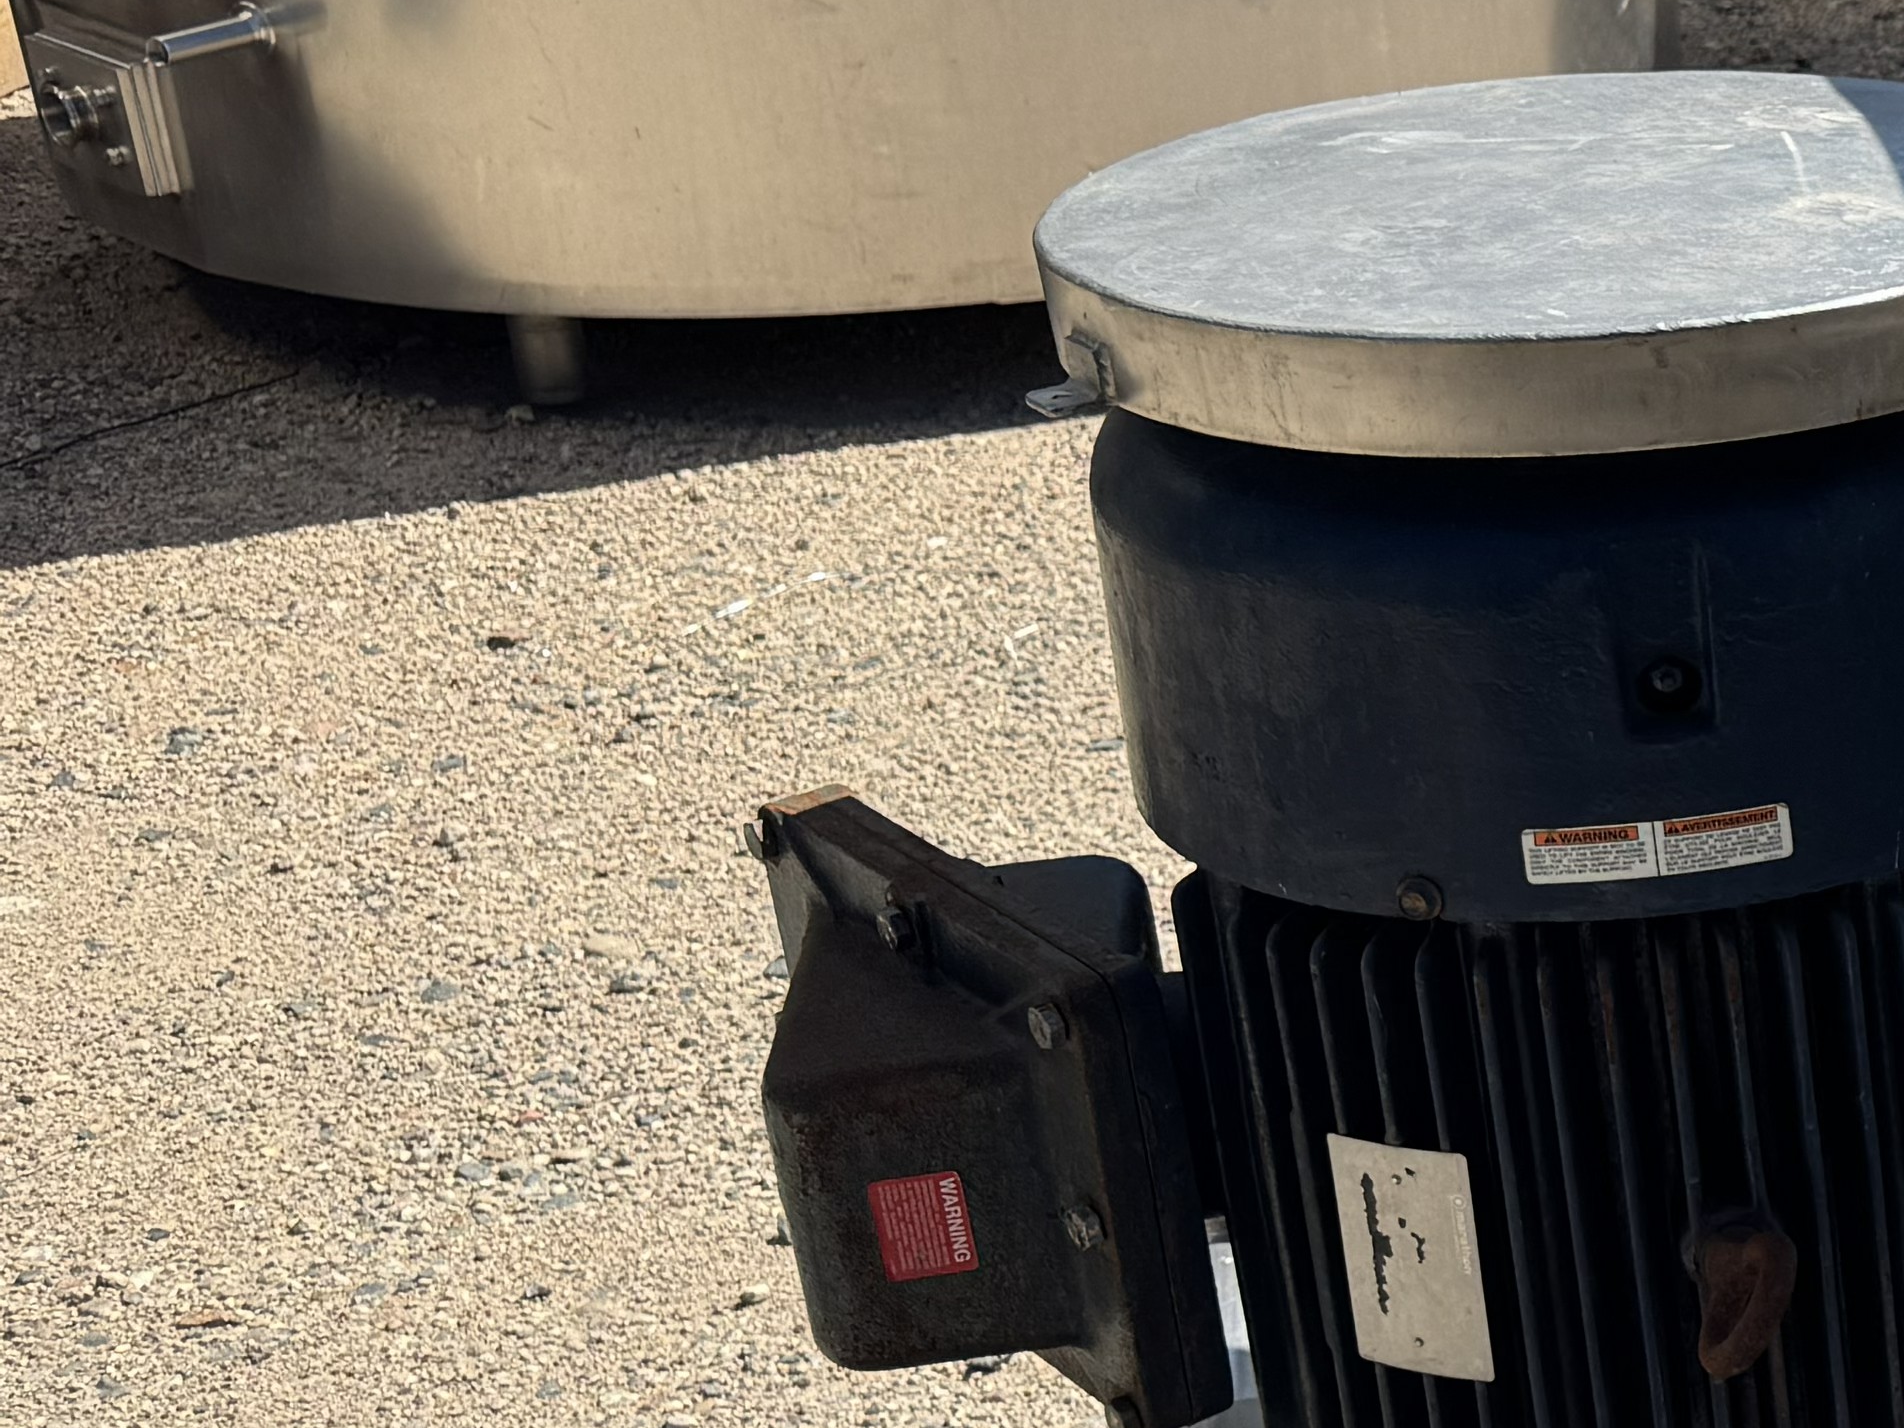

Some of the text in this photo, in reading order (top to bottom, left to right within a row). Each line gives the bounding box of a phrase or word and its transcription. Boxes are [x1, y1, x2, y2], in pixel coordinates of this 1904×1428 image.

[1681, 810, 1775, 833] AVERTISSEMENT
[1559, 829, 1630, 844] WARNING
[939, 1177, 971, 1263] WARNING
